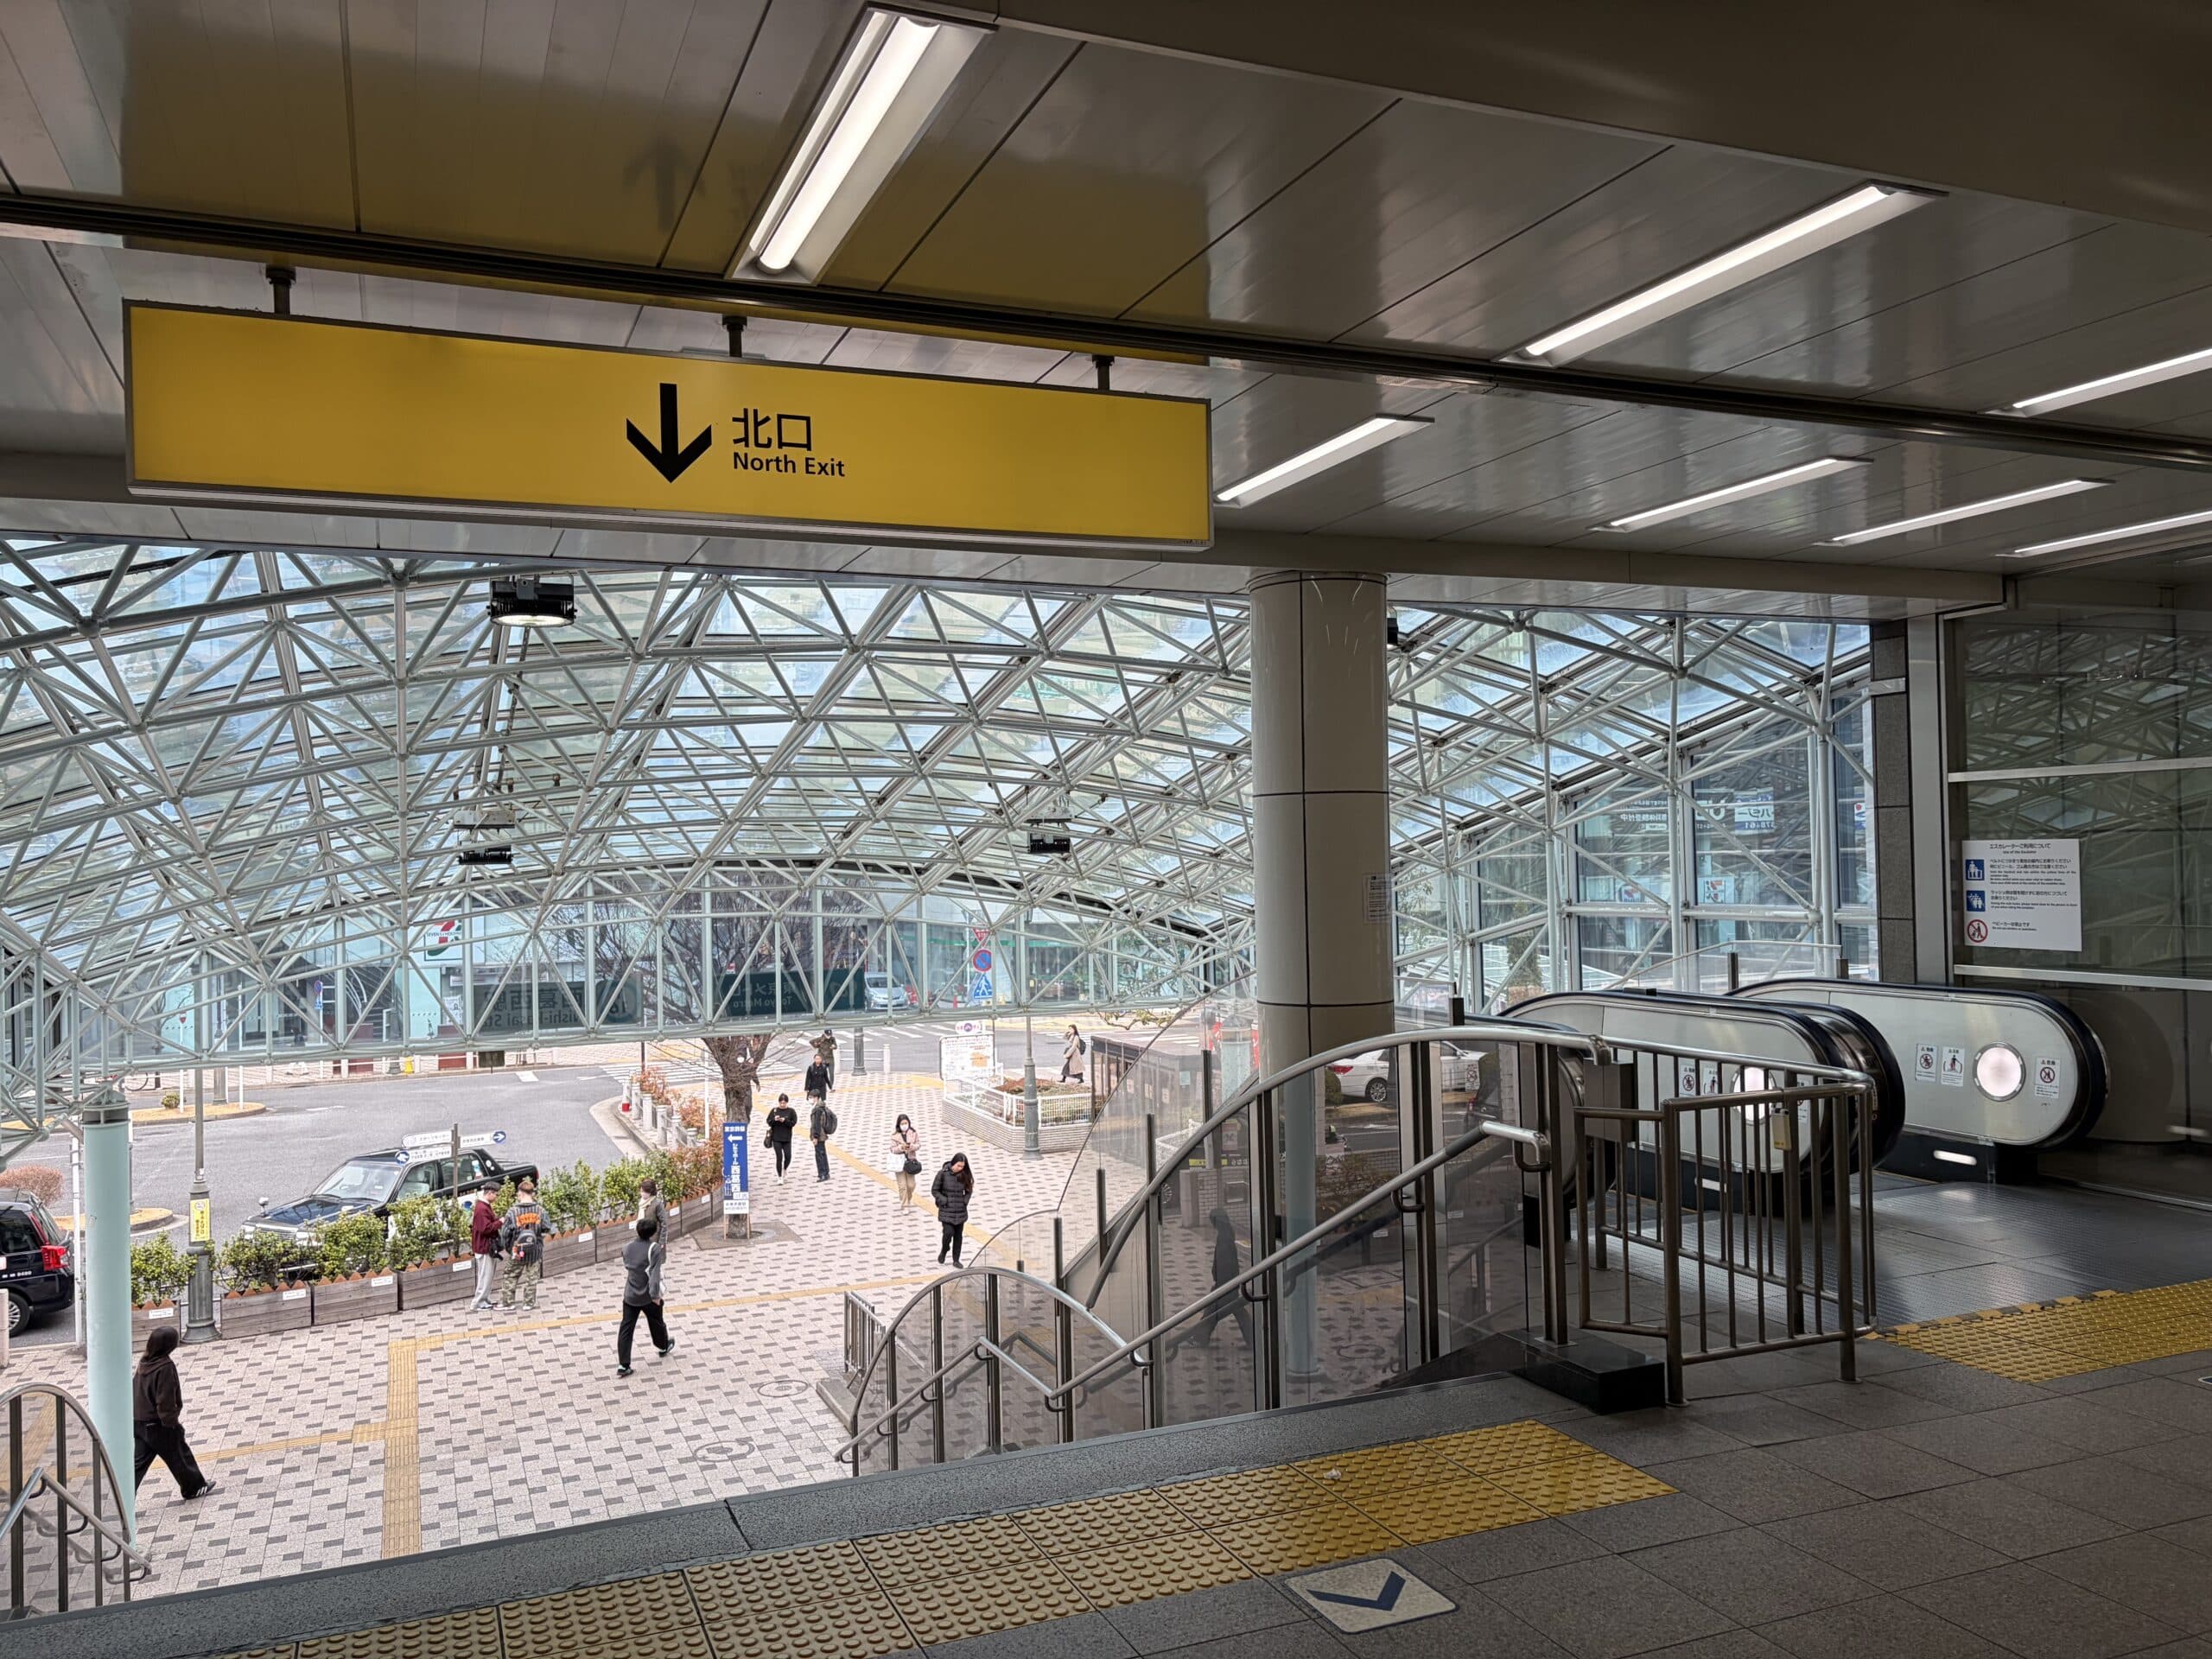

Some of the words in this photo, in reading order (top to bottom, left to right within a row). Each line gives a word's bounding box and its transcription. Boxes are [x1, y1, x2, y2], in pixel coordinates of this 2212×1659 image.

[732, 408, 812, 451] 北口
[733, 452, 796, 474] North
[804, 457, 845, 477] Exit
